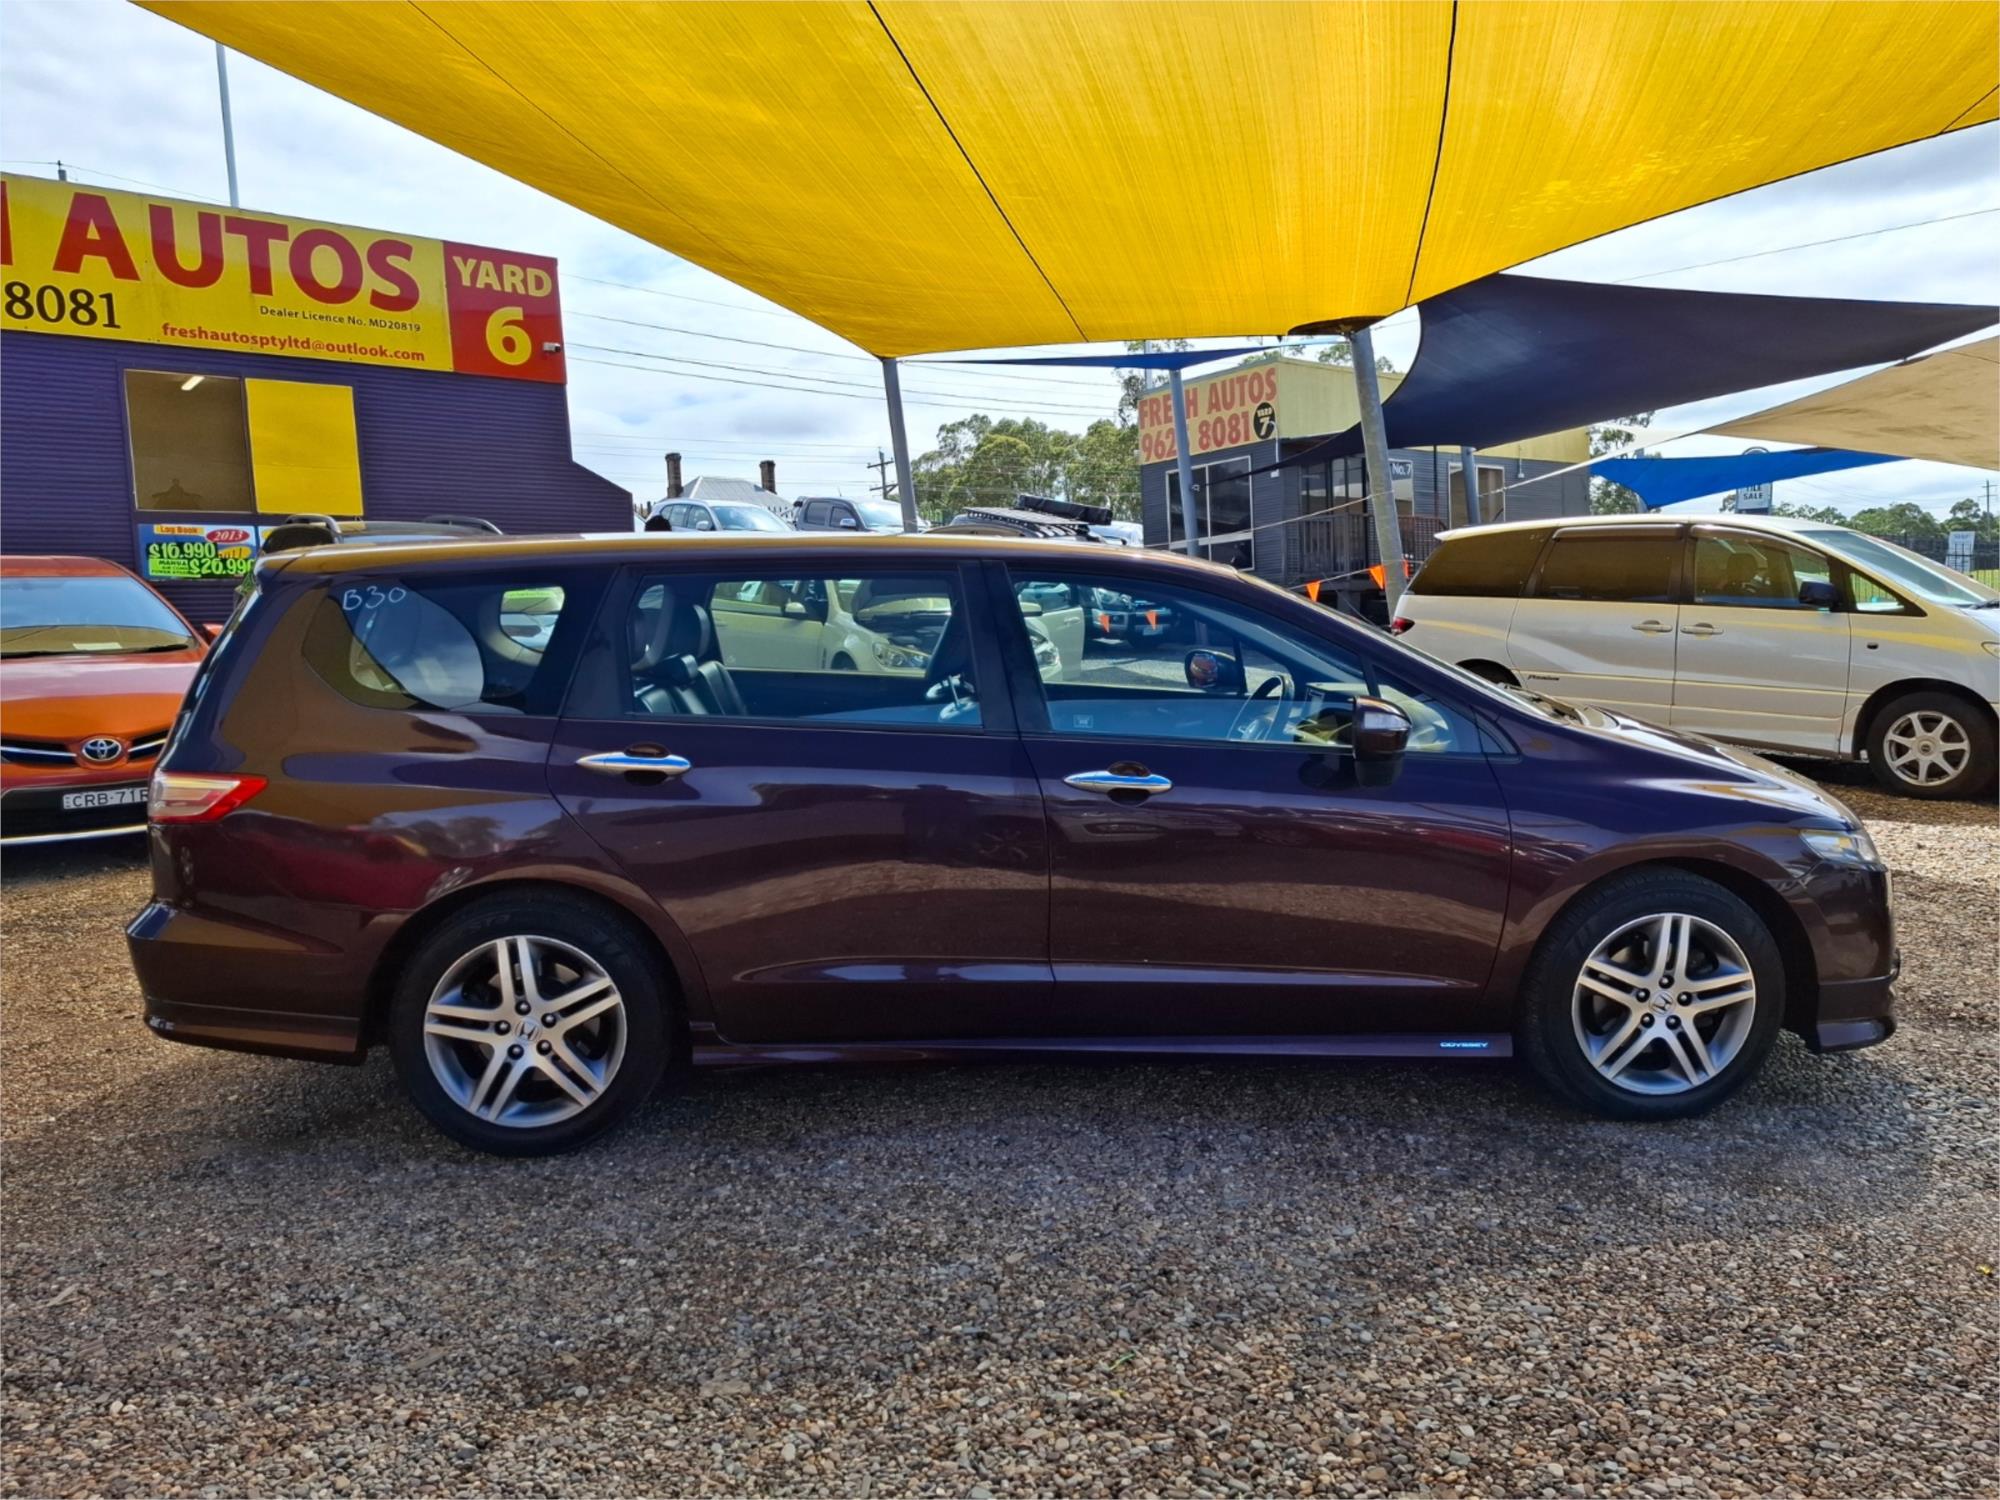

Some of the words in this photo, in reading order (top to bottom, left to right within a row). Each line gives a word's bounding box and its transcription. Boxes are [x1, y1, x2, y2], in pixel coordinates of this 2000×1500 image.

[52, 191, 420, 313] AUTOS
[452, 255, 553, 297] YARD
[4, 281, 121, 330] 8081
[259, 305, 299, 320] Dealer
[302, 310, 345, 325] Licence
[347, 316, 367, 328] No.
[369, 318, 421, 333] MD20819
[162, 322, 426, 363] freshautosptyltd@outlook.com
[485, 306, 533, 366] 6
[1138, 386, 1199, 430] FREH
[1207, 367, 1278, 415] AUTOS
[1141, 427, 1190, 463] 962
[1198, 410, 1250, 451] 8081
[1259, 416, 1270, 437] 7
[341, 585, 407, 611] B30
